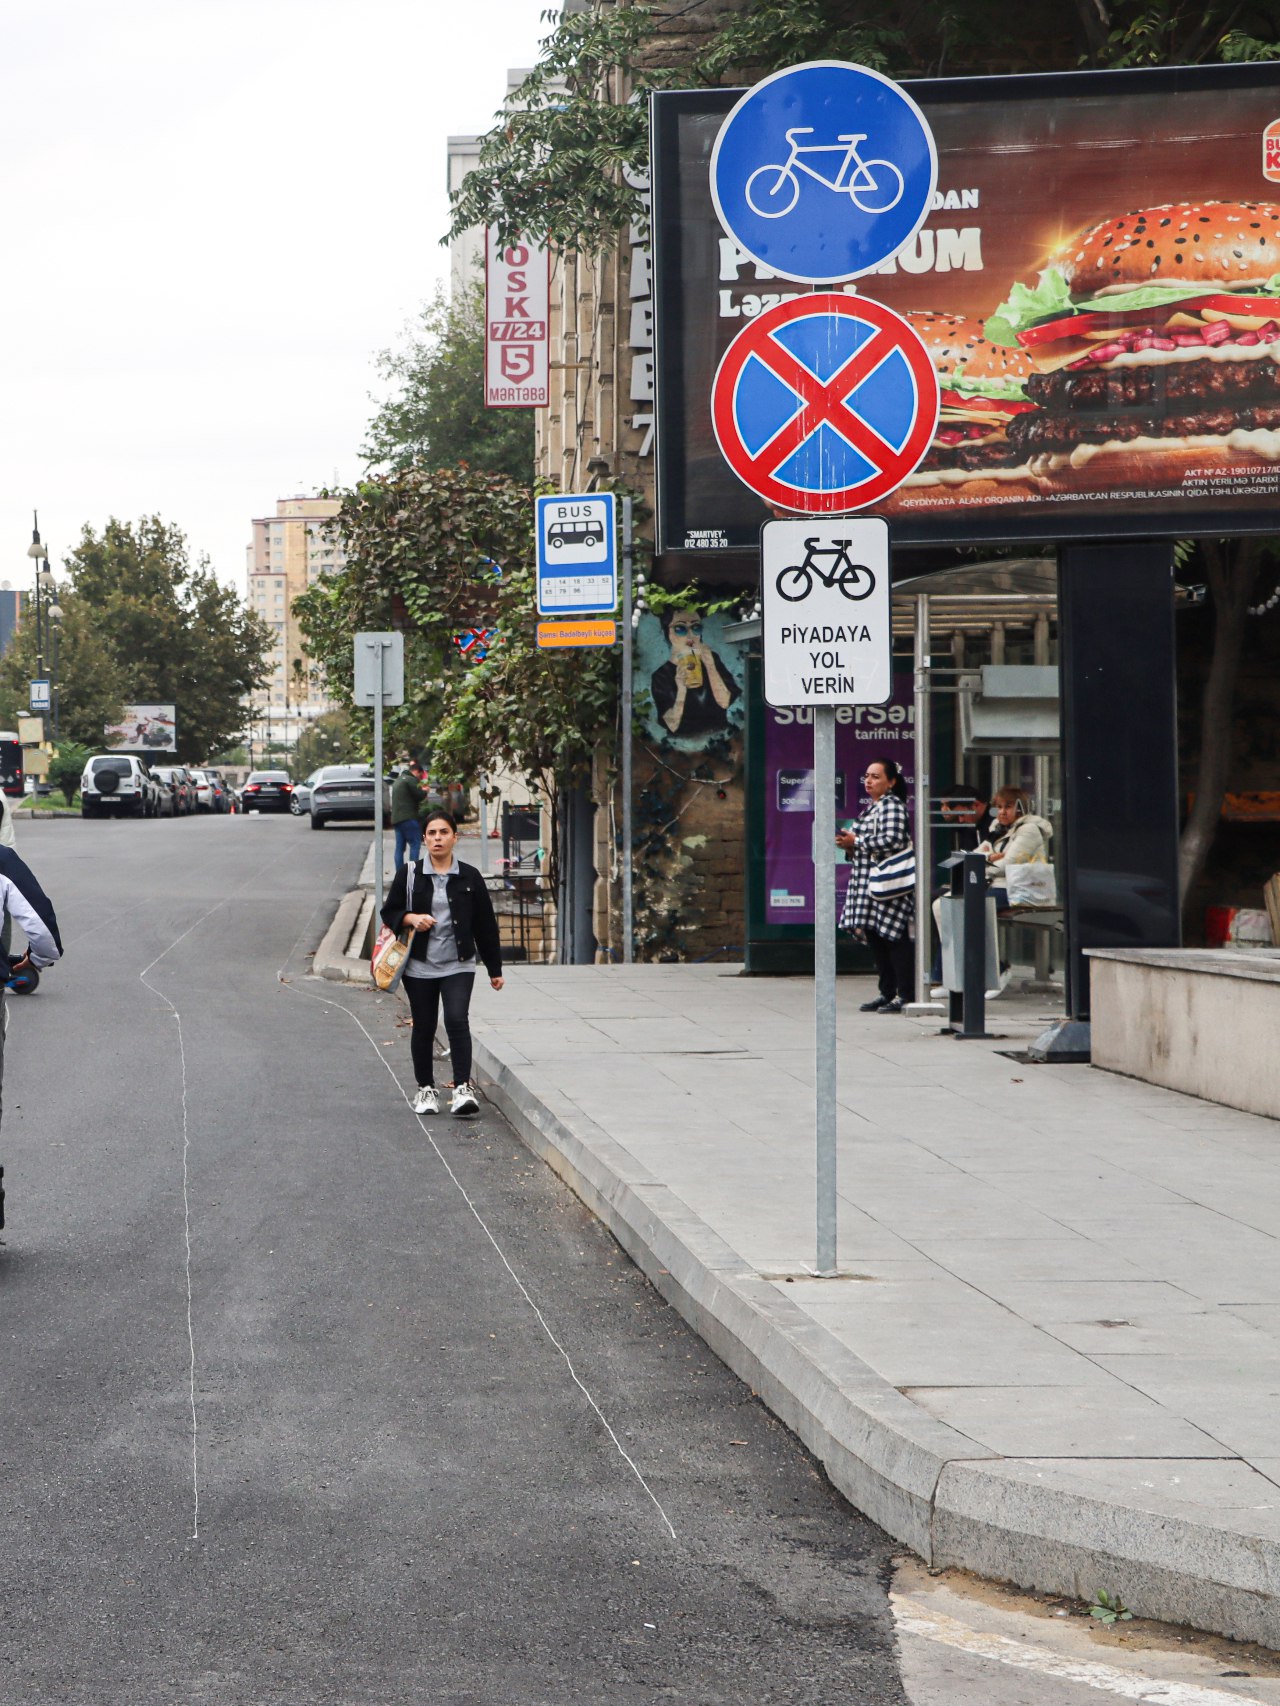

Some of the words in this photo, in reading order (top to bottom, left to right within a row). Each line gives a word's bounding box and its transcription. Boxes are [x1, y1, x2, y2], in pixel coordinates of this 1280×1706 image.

[492, 323, 542, 341] 7/24
[505, 348, 531, 376] 5
[489, 387, 545, 402] MƏRTƏBƏ
[1185, 469, 1203, 477] AKT
[959, 497, 982, 505] ALAN
[985, 496, 1024, 505] ORQANIN
[558, 505, 592, 518] BUS
[684, 538, 696, 548] 012
[710, 538, 719, 548] 35
[719, 538, 728, 548] 20
[781, 623, 872, 644] PİYADAYA
[809, 651, 845, 669] YOL
[801, 673, 854, 694] VERİN
[774, 704, 916, 725] SuerSə
[855, 727, 899, 740] tarifini
